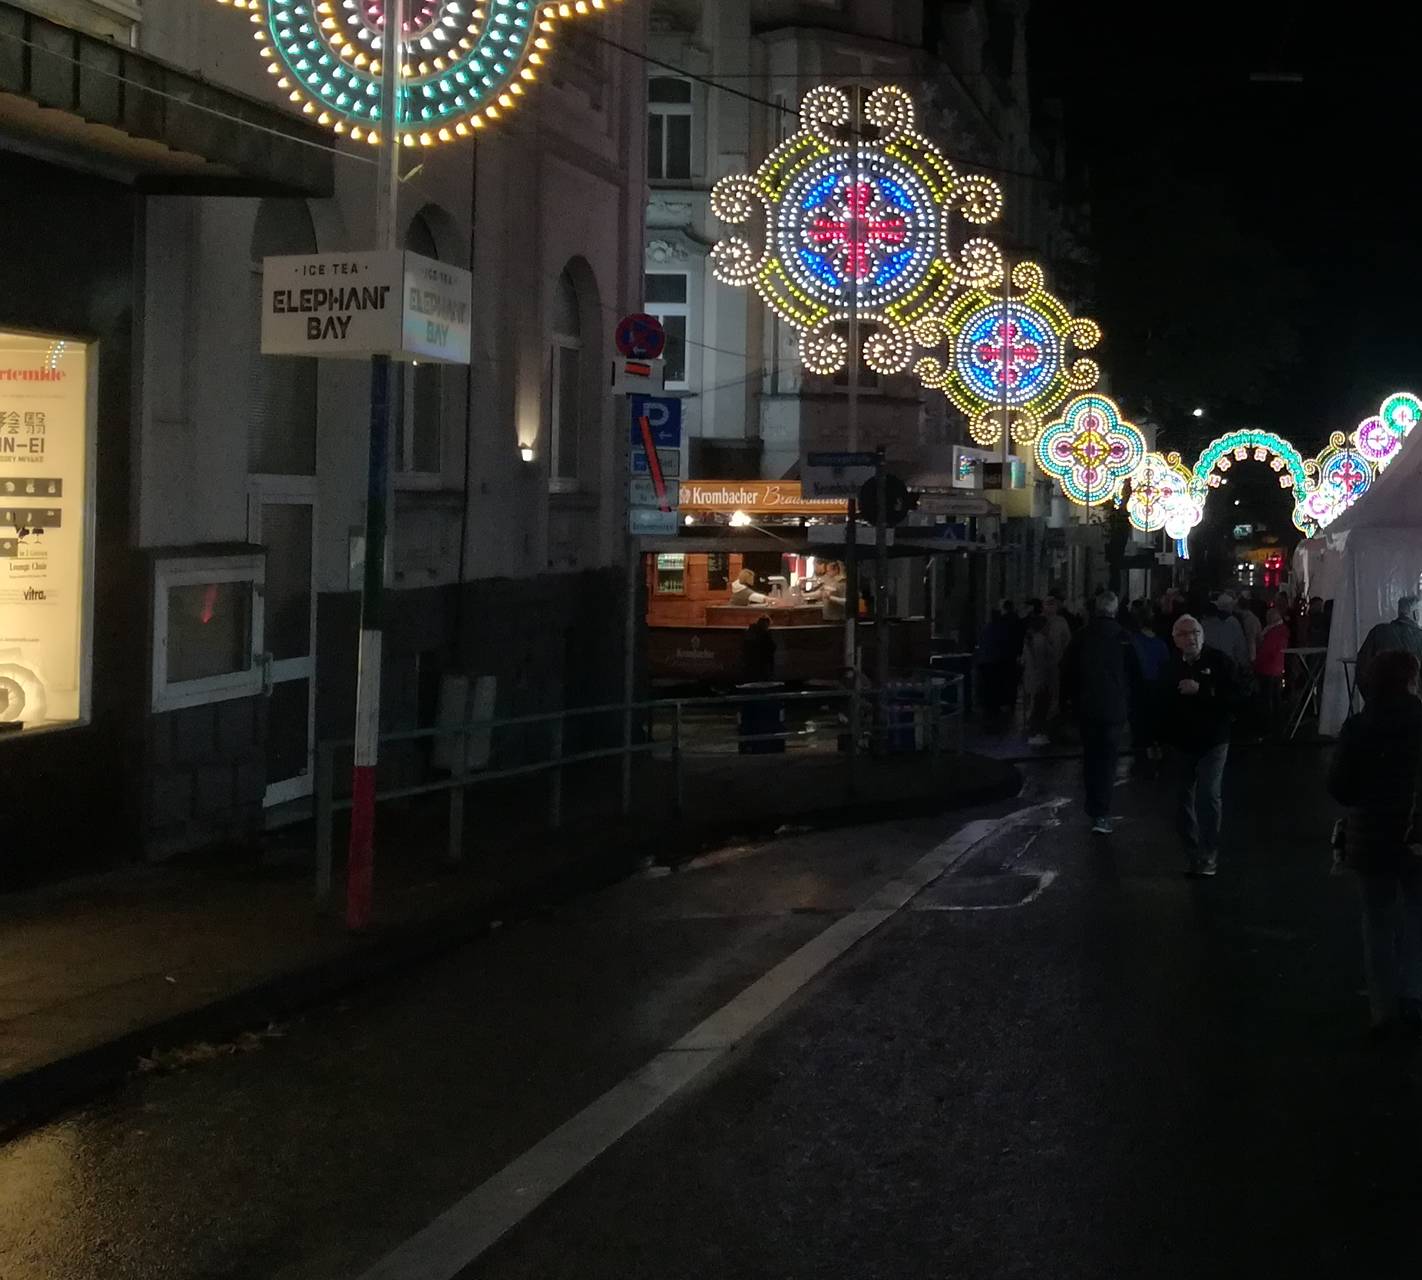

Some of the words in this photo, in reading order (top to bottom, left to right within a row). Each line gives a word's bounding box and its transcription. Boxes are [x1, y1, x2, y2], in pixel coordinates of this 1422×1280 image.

[303, 264, 325, 275] ICE
[333, 263, 358, 275] TEA
[273, 286, 390, 313] ELEPHANT
[409, 287, 466, 325] ELEPHANT
[307, 315, 352, 340] BAY
[426, 320, 449, 347] BAY
[692, 487, 758, 505] Krombacher
